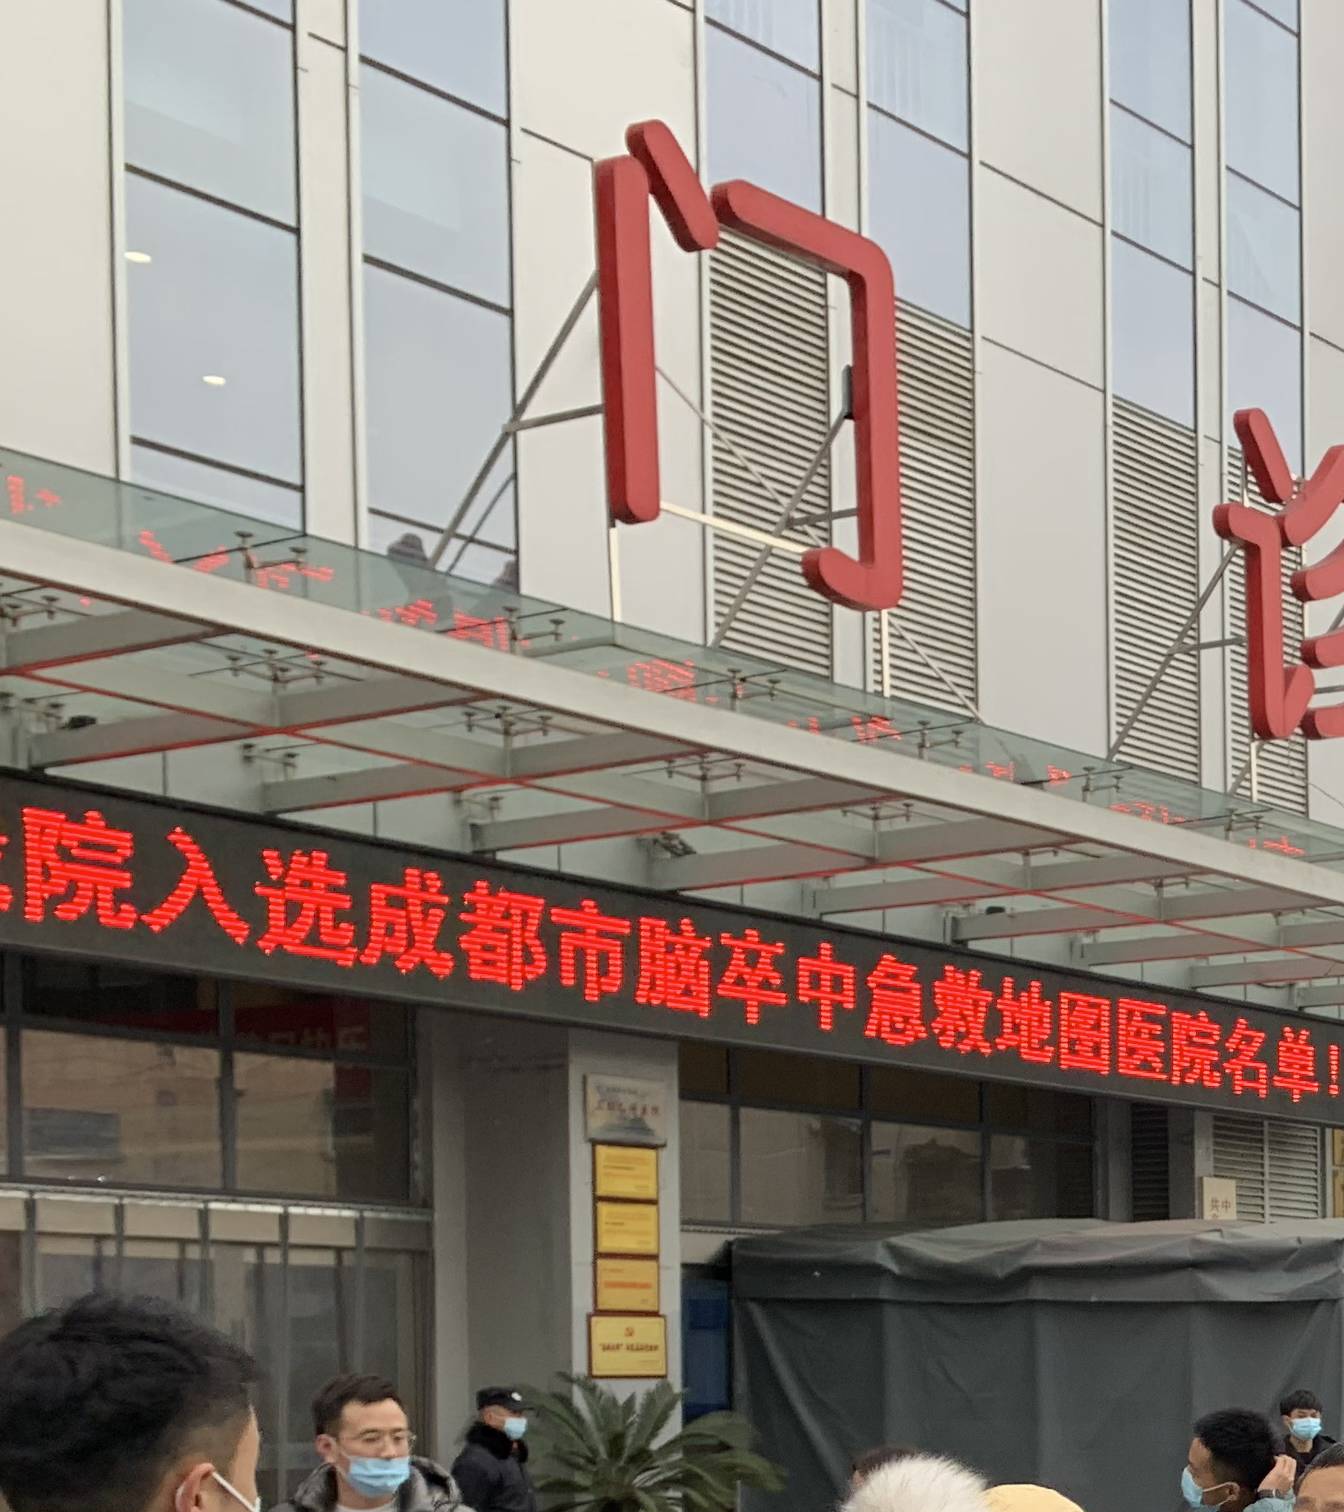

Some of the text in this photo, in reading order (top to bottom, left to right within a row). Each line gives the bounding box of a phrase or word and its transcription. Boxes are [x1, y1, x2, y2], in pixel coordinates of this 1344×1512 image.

[0, 805, 1341, 1103] 院入选成都市脑卒中急救地图医院名单！
